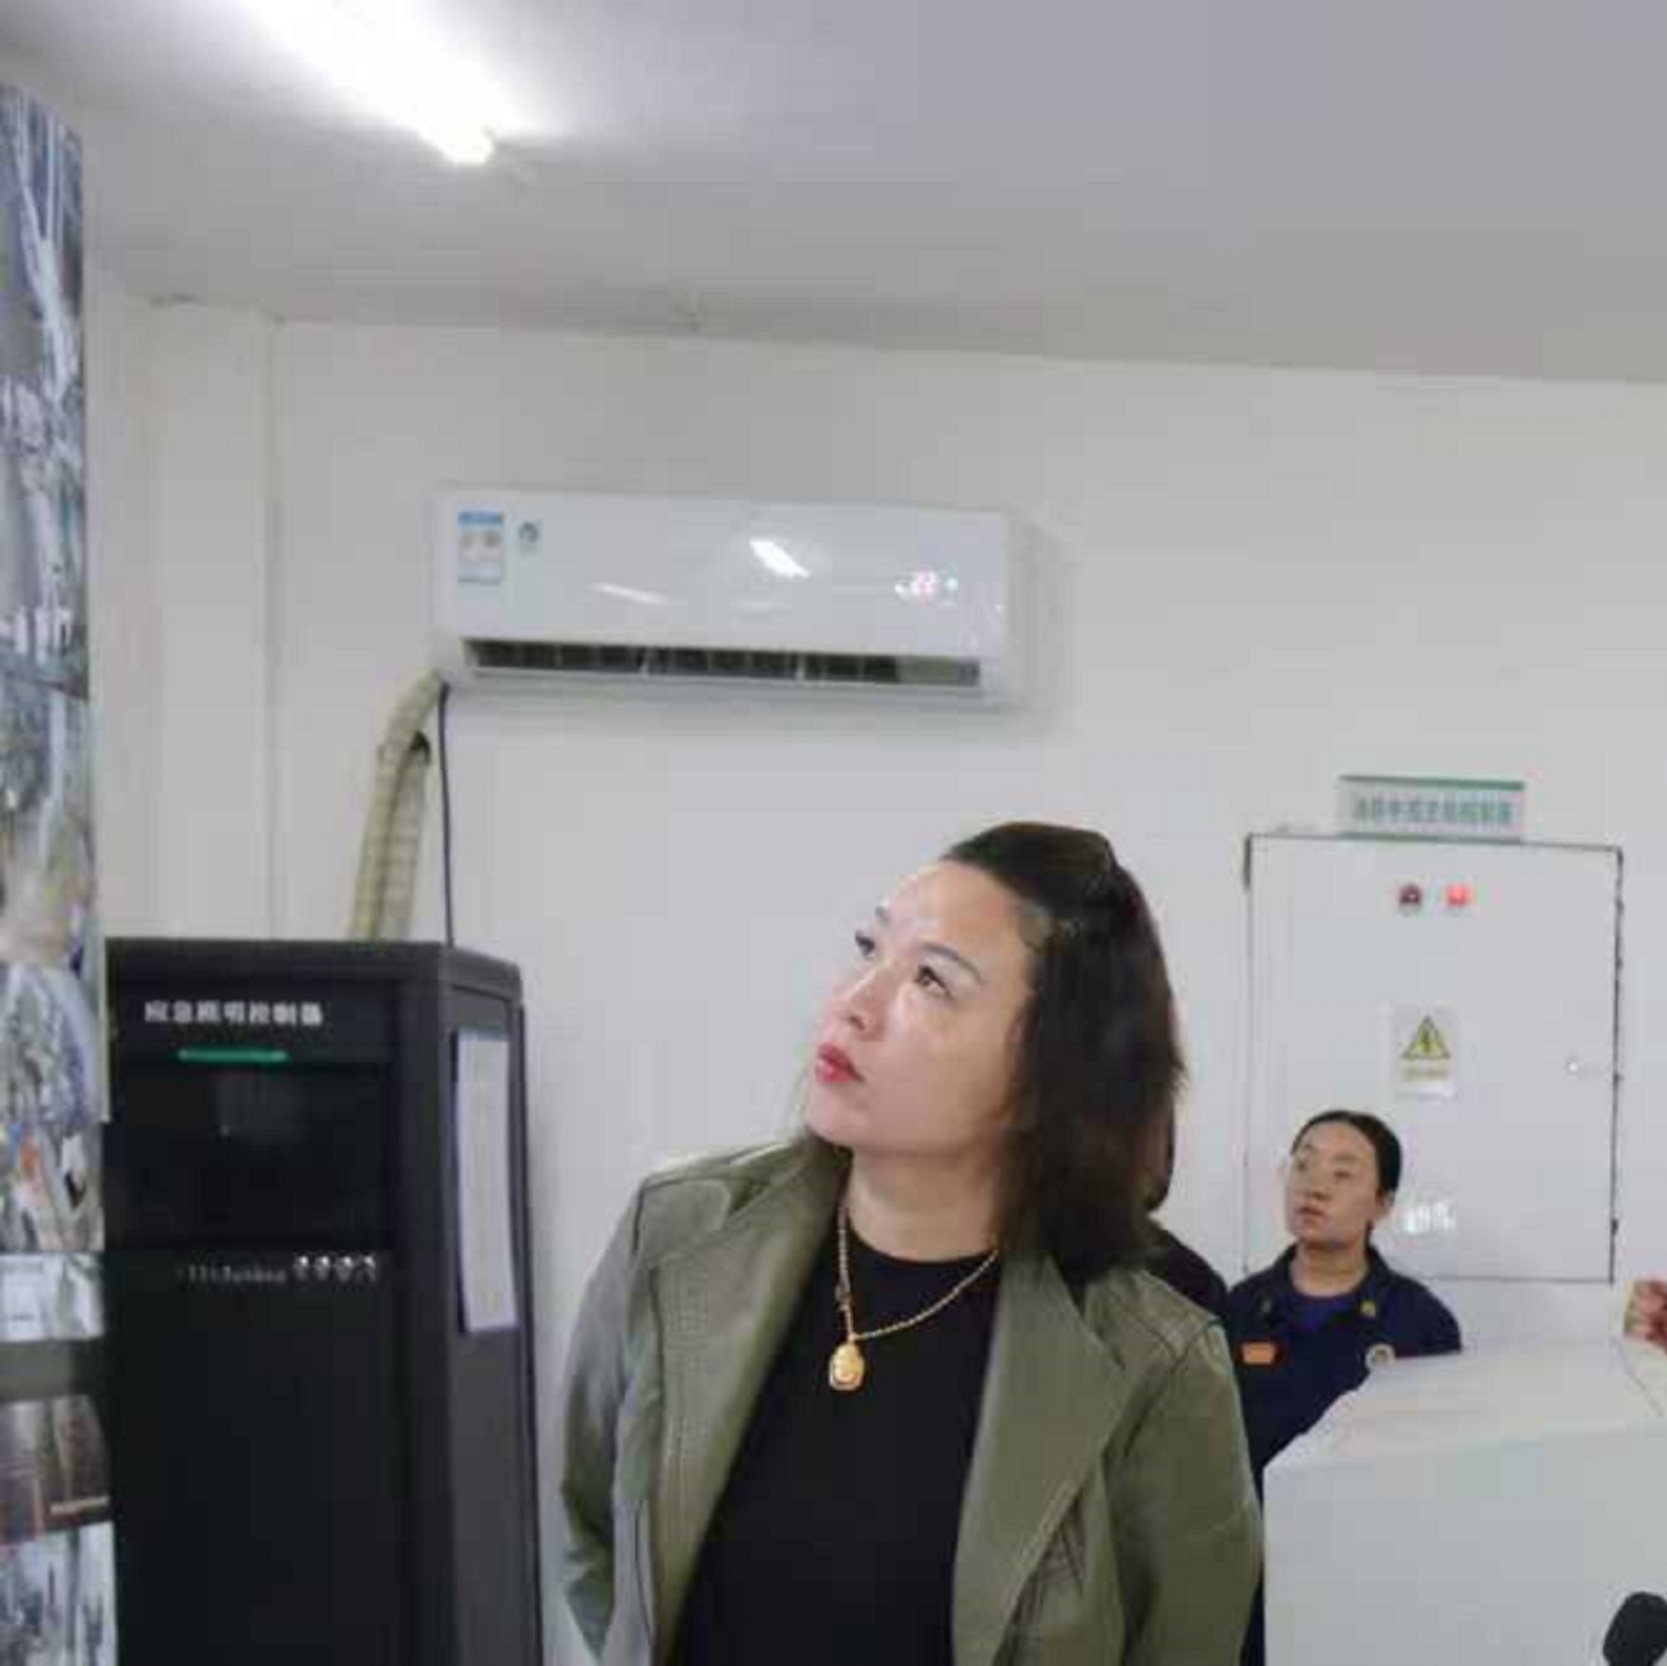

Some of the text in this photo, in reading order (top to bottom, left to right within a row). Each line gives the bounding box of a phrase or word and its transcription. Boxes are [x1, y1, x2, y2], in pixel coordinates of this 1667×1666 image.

[145, 1000, 323, 1026] 应急照明控制器
